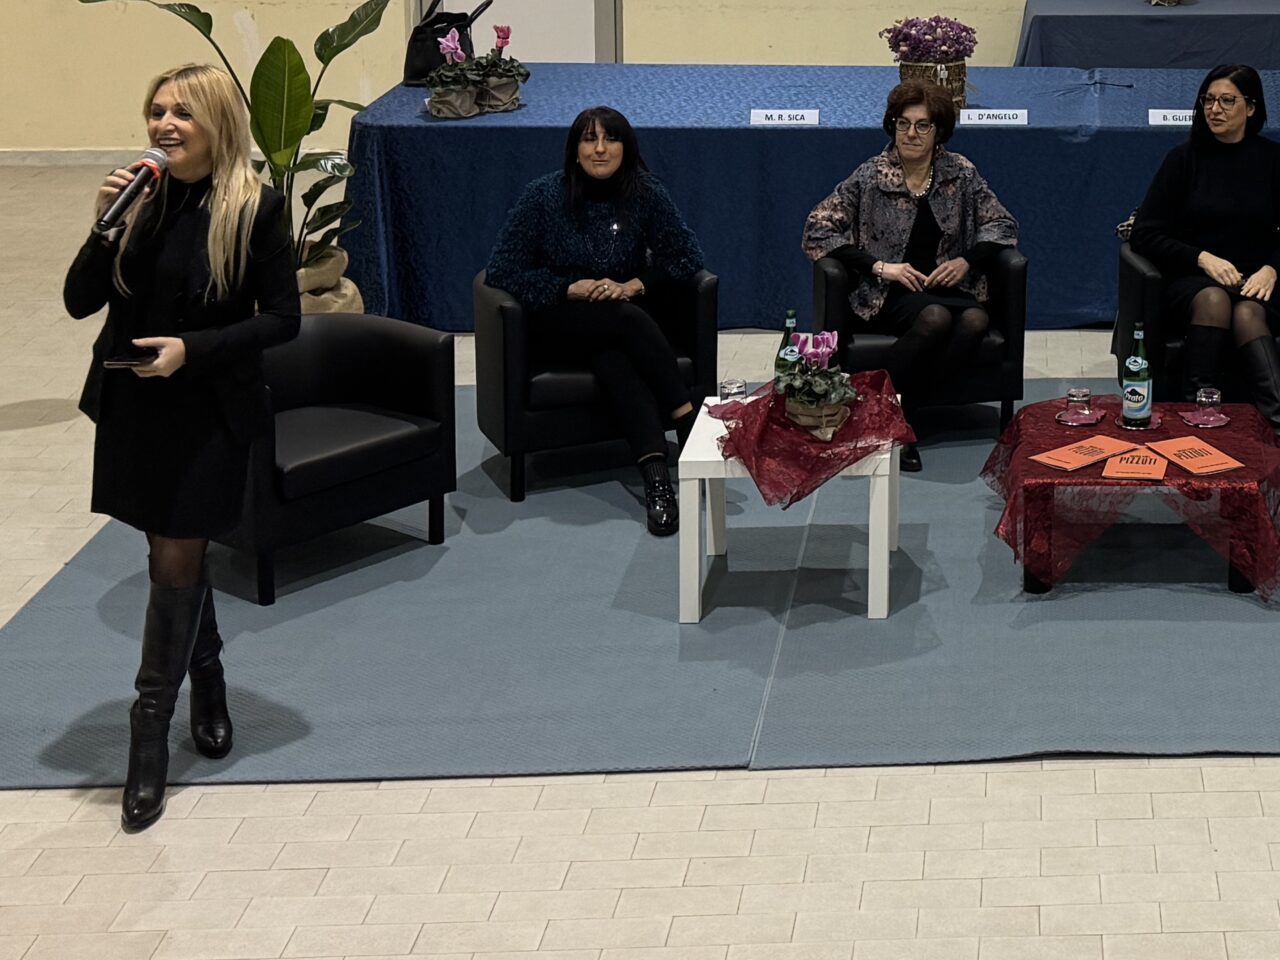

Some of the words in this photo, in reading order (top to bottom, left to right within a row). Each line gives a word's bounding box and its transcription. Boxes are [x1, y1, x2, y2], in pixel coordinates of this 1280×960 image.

[764, 113, 776, 121] M.
[777, 113, 786, 121] R.
[787, 113, 806, 122] SICA
[977, 112, 1019, 121] D'ANGELO
